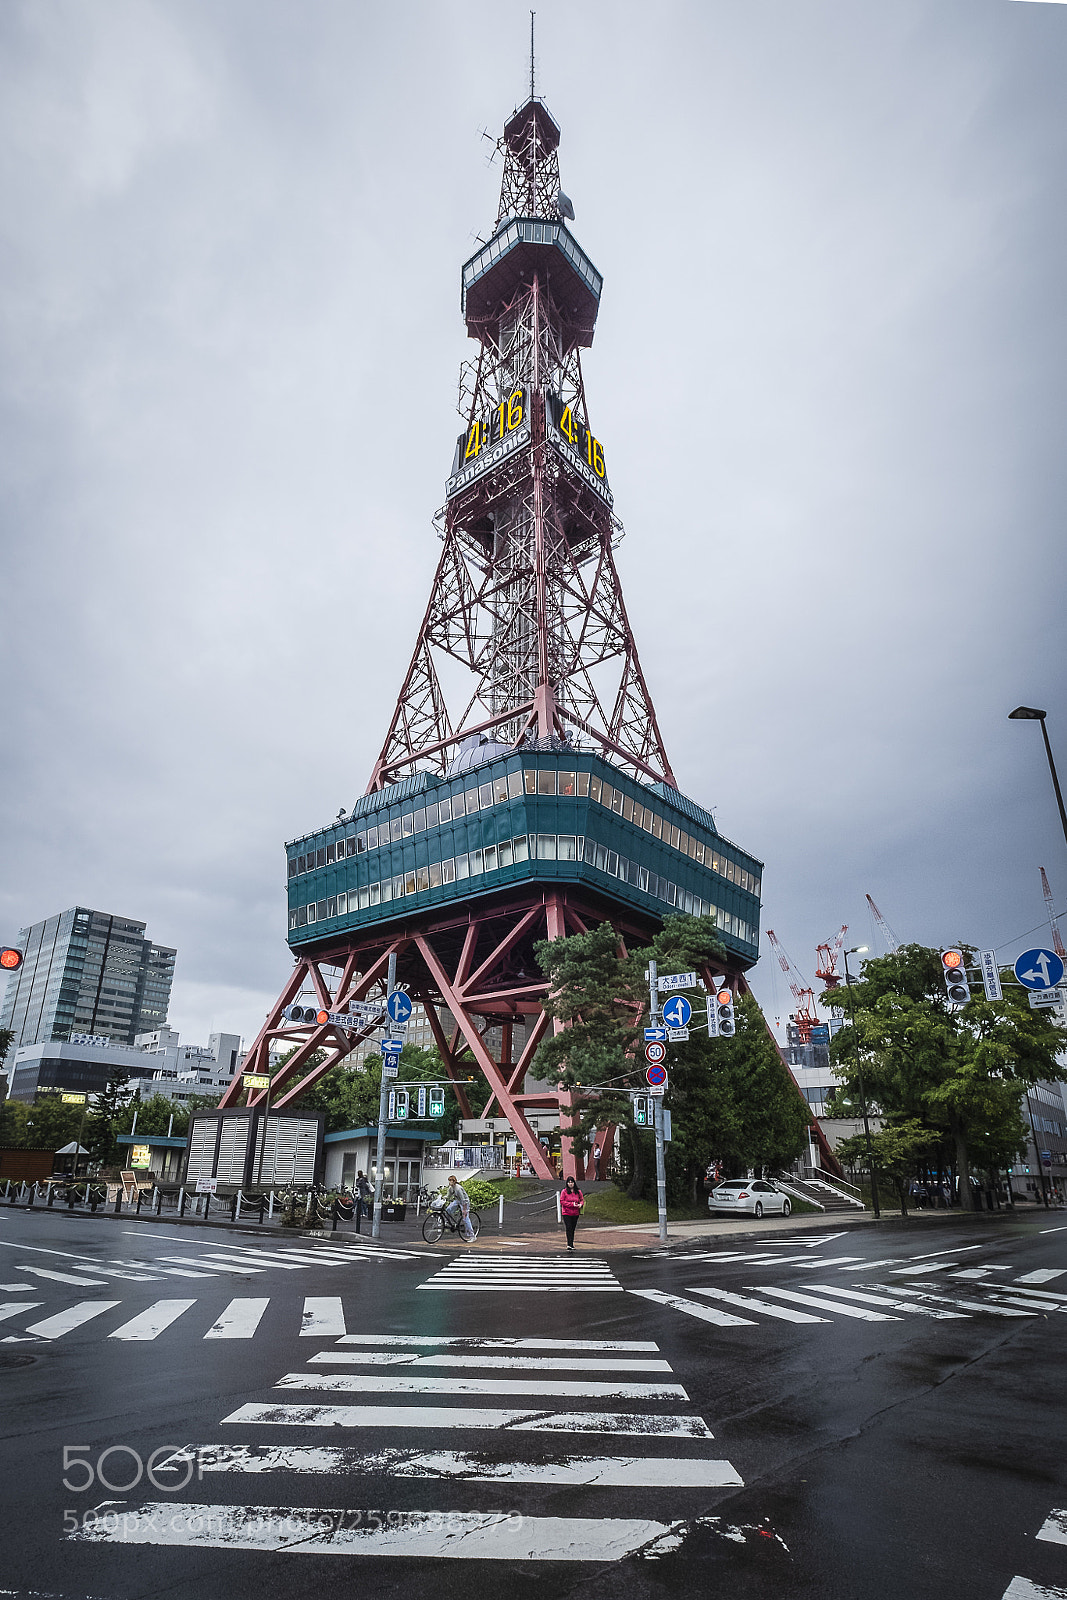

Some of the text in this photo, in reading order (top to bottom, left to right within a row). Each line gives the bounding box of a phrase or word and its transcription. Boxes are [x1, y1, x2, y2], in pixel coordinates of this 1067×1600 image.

[465, 389, 523, 459] 4:16
[560, 405, 605, 478] 4:16
[447, 428, 529, 496] Panasonic
[549, 426, 614, 505] Panasonic
[650, 1047, 661, 1058] 50
